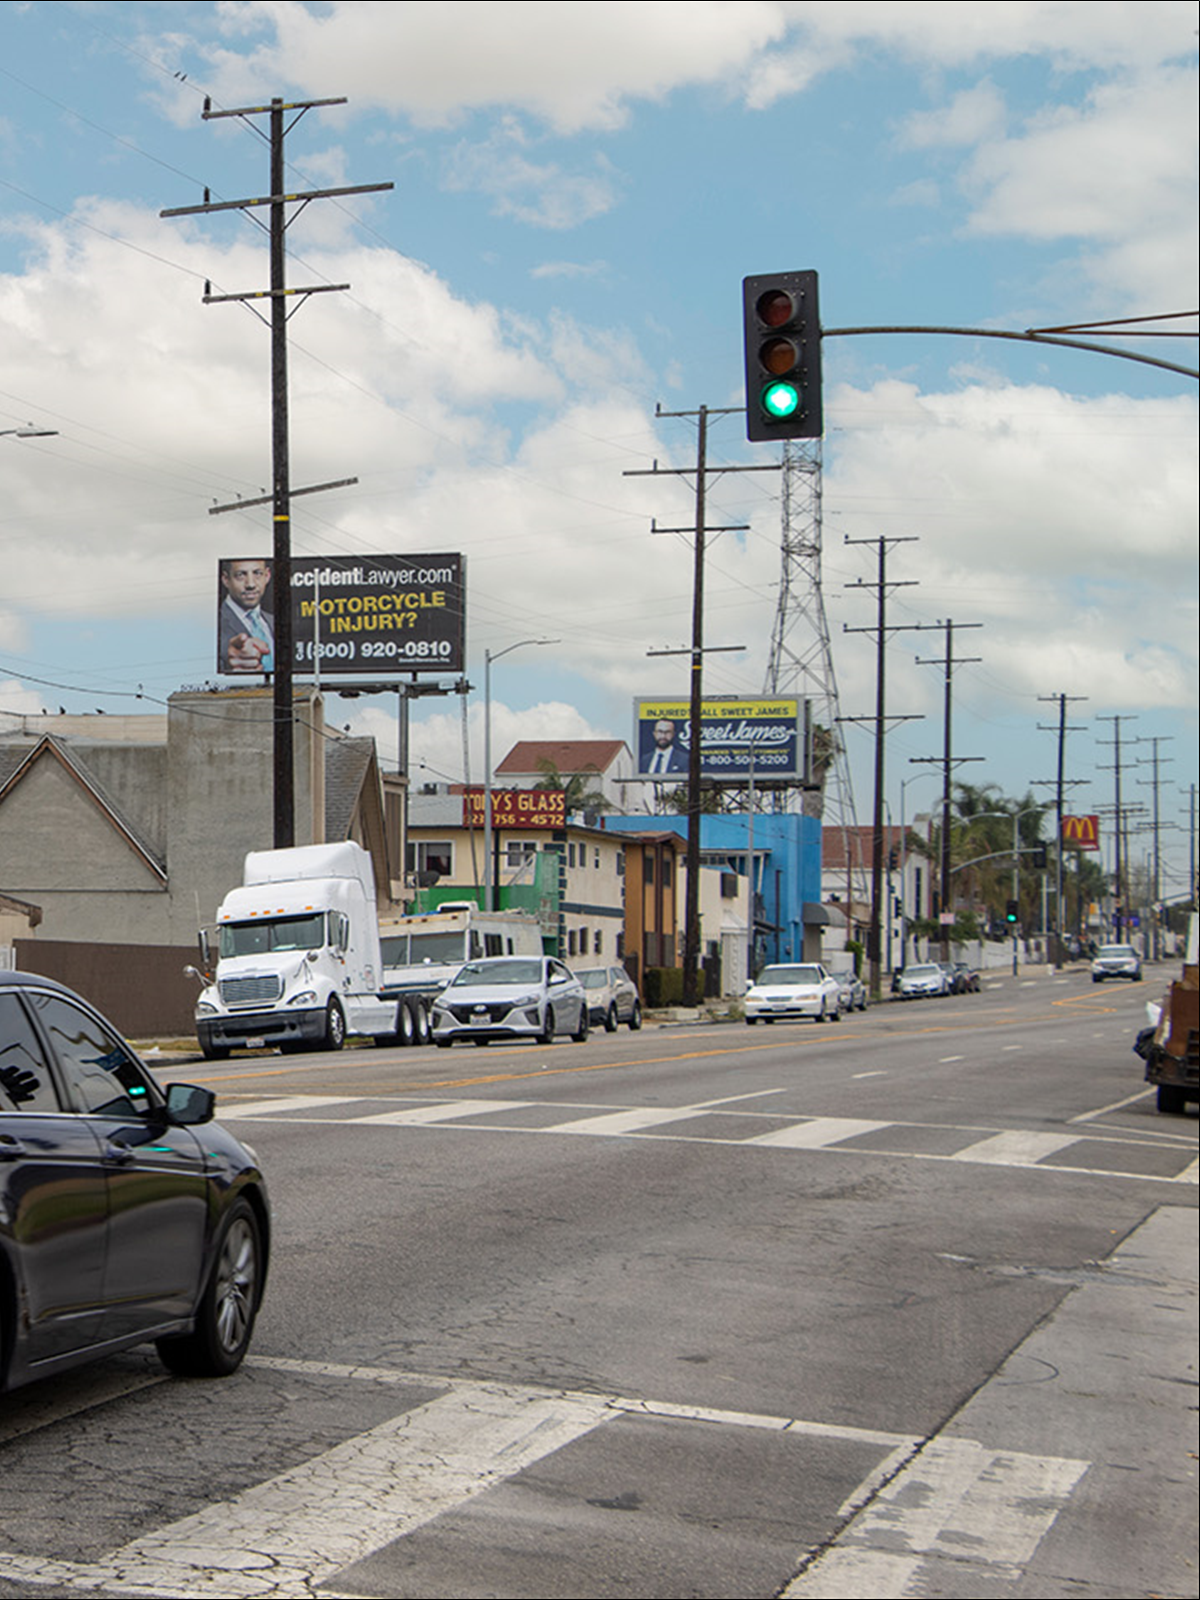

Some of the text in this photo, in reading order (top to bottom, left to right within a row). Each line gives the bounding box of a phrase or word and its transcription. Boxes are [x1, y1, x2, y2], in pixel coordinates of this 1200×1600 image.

[301, 591, 446, 616] MOTORCYCLE
[330, 612, 418, 633] INJURY?
[307, 641, 355, 660] (800)
[361, 640, 451, 658] 920-0810
[700, 708, 718, 717] ALL
[721, 707, 753, 716] SWEET
[755, 707, 789, 716] JAMES
[730, 720, 790, 741] James
[464, 792, 565, 811] TOY'S GLASS
[494, 814, 516, 825] 756
[530, 814, 564, 826] 4572
